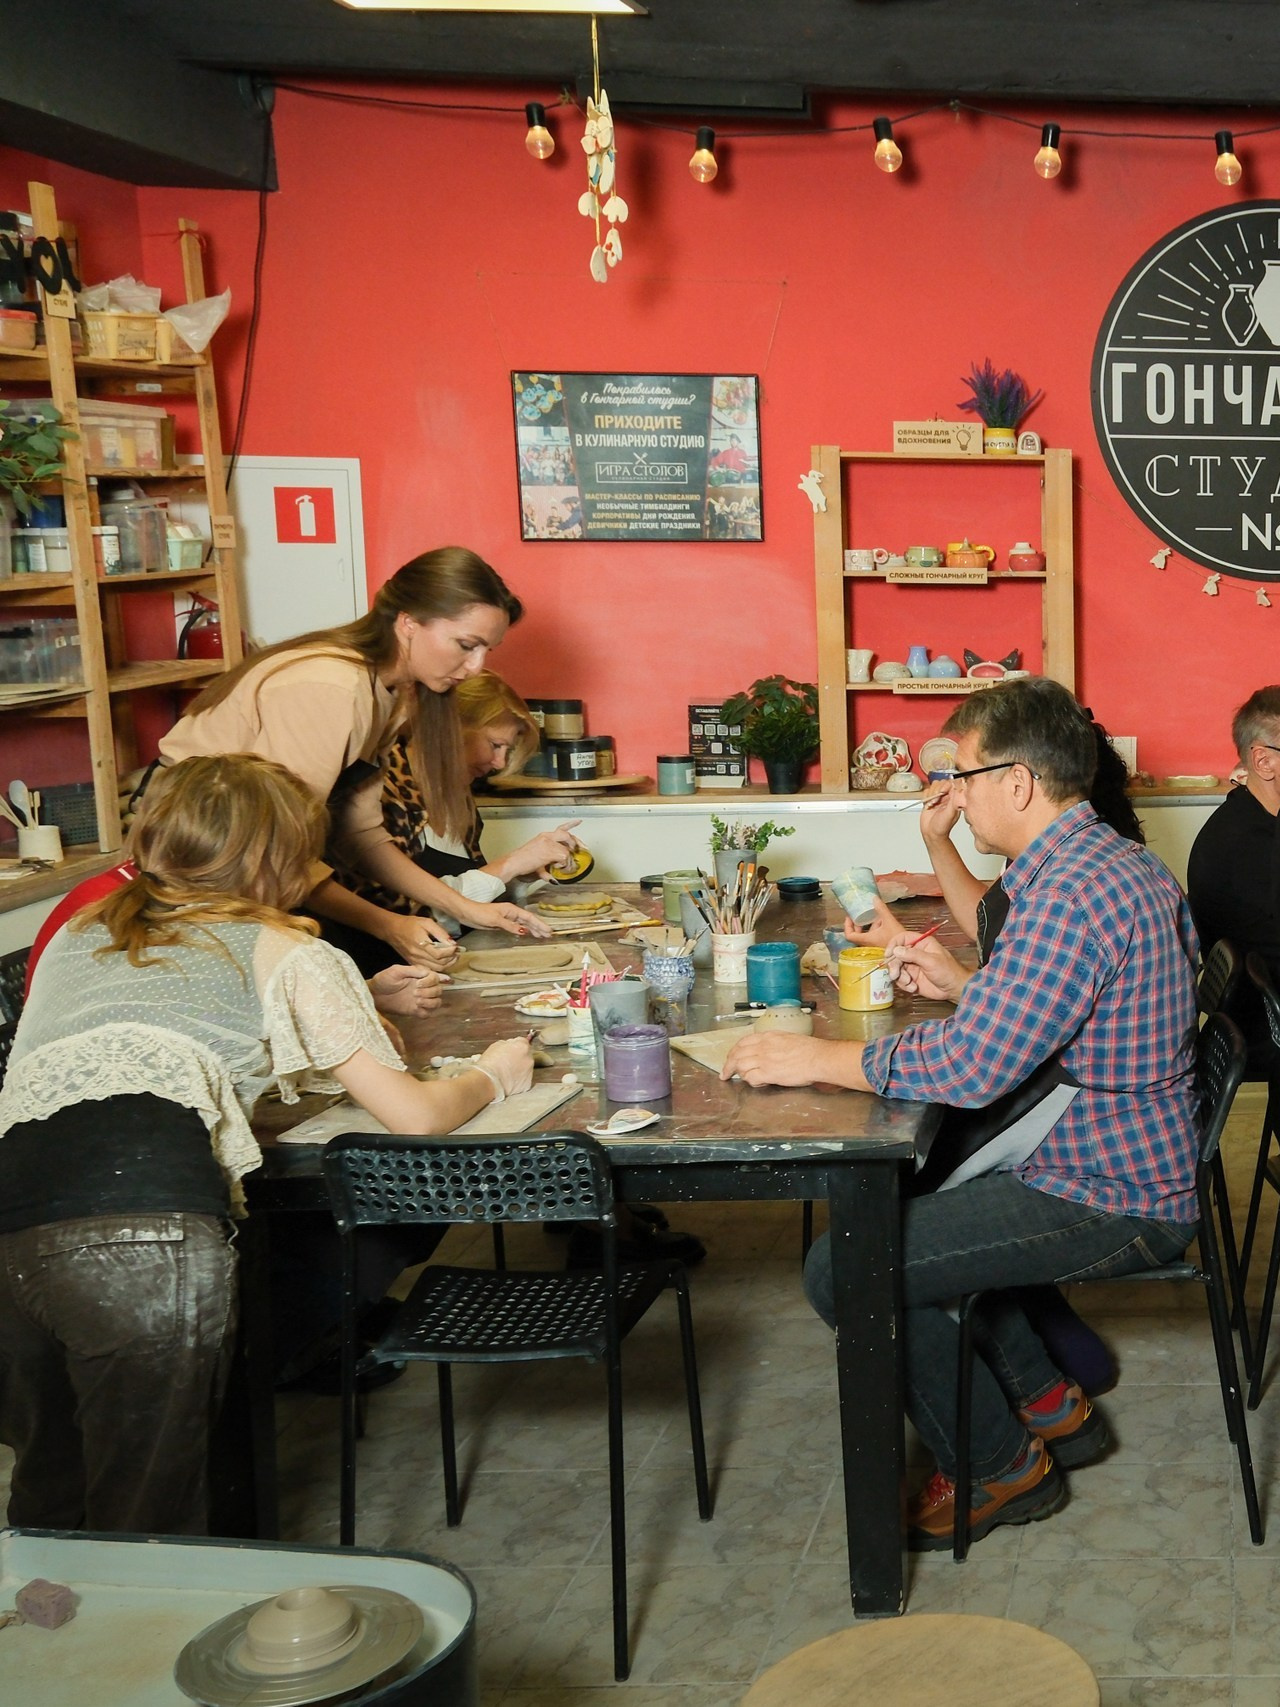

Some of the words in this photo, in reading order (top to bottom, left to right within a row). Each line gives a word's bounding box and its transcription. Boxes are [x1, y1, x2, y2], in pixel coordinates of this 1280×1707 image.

[603, 383, 672, 395] Понравилось
[580, 392, 589, 404] в
[590, 393, 646, 407] Гончарной
[647, 394, 696, 410] студии?
[594, 415, 682, 431] ПРИХОДИТЕ
[575, 434, 583, 447] В
[585, 434, 658, 447] КУЛИНАРНУЮ
[660, 435, 705, 449] СТУДИЮ
[599, 465, 631, 477] ИГРА
[633, 465, 685, 477] СТОЛОВ
[641, 503, 690, 511] ТИМБИЛДИНГИ
[592, 512, 641, 520] КОРПОРАТИВЫ
[629, 522, 660, 530] ДЕТСКИЕ
